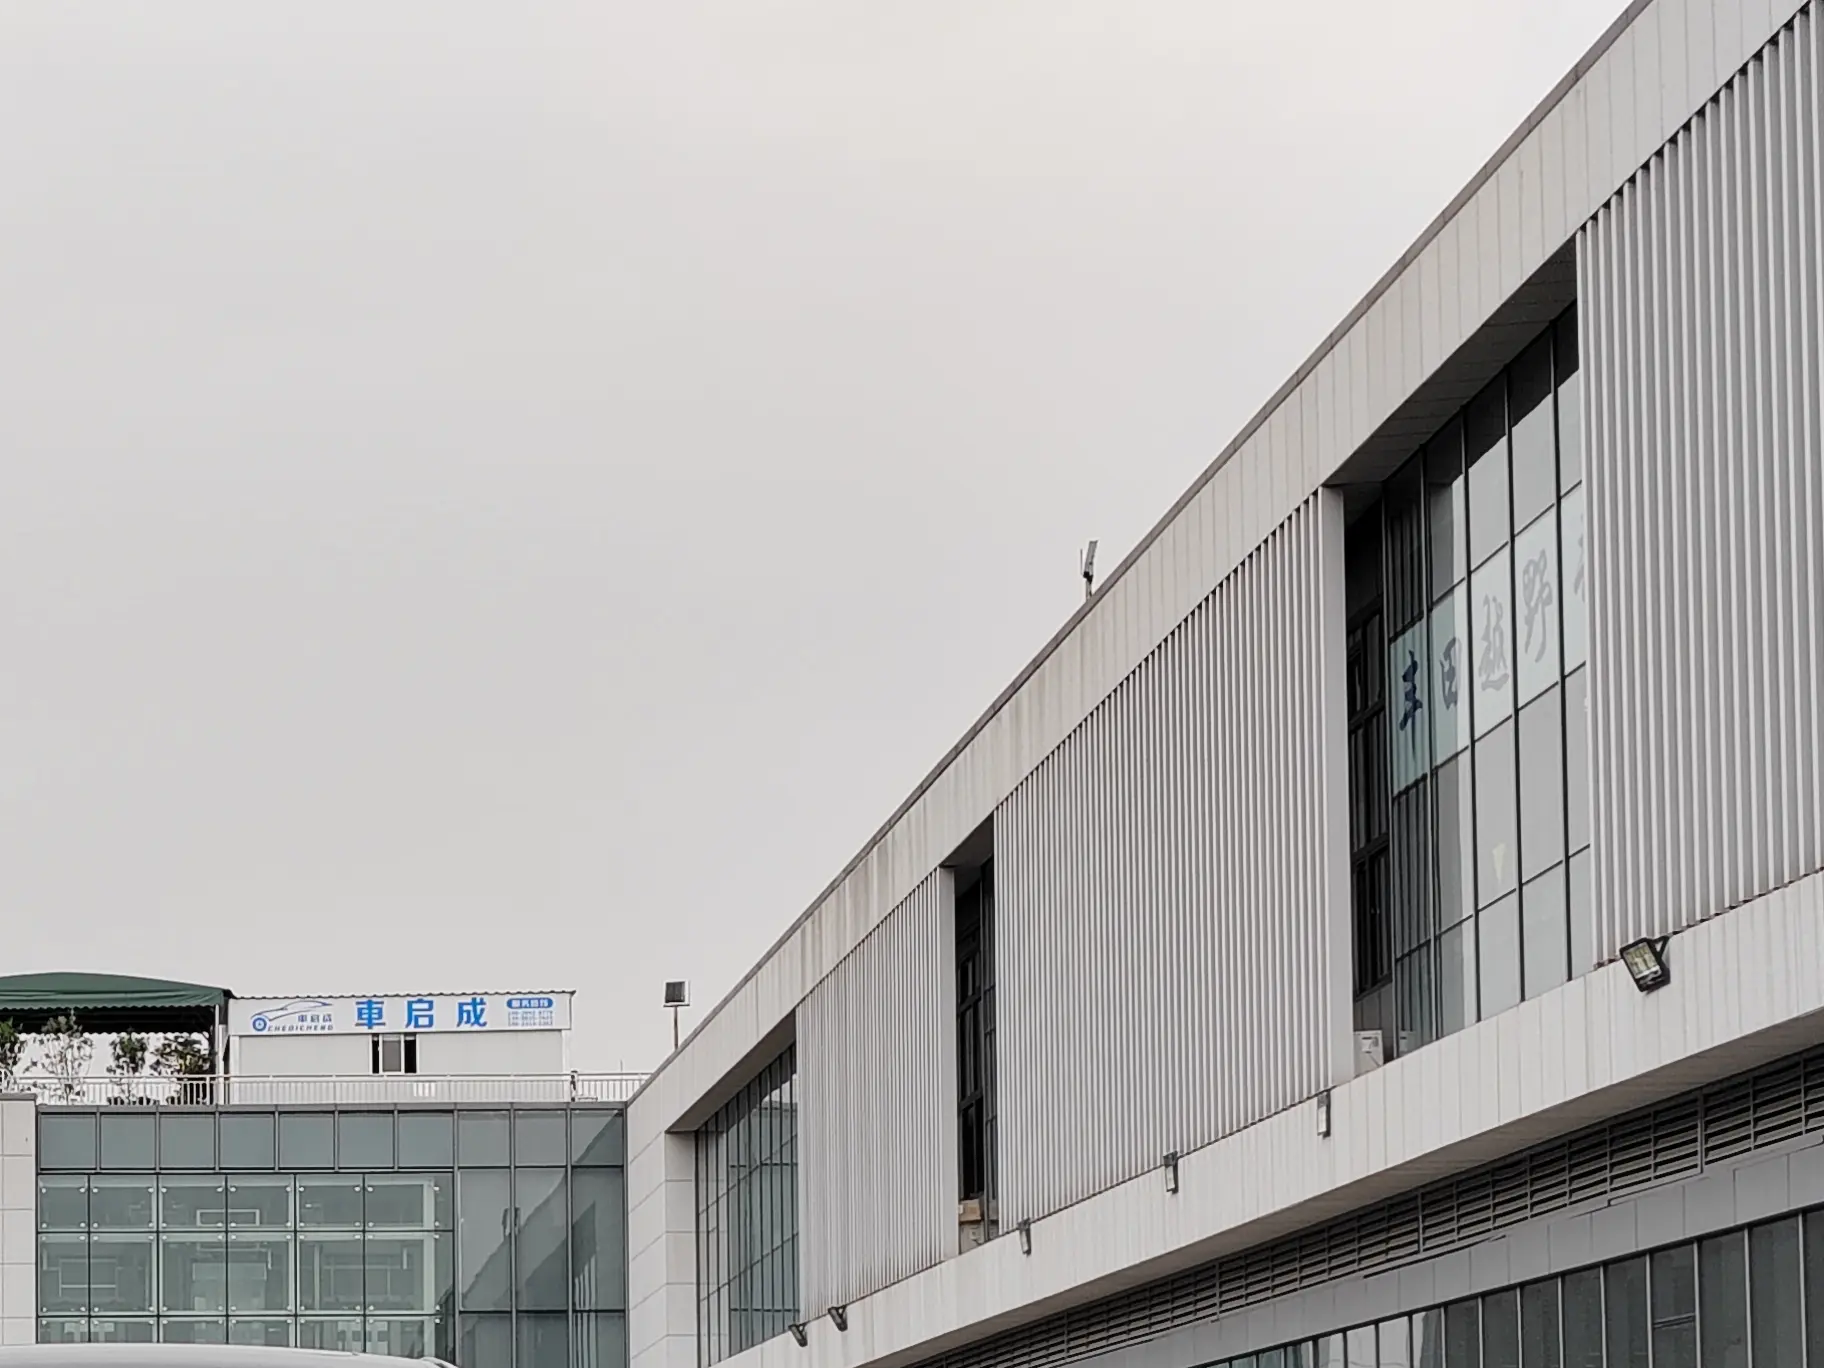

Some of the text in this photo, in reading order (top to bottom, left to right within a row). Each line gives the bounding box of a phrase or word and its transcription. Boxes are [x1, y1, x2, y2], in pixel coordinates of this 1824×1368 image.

[1399, 515, 1586, 764] 丰田越野
[354, 997, 488, 1030] 車启成
